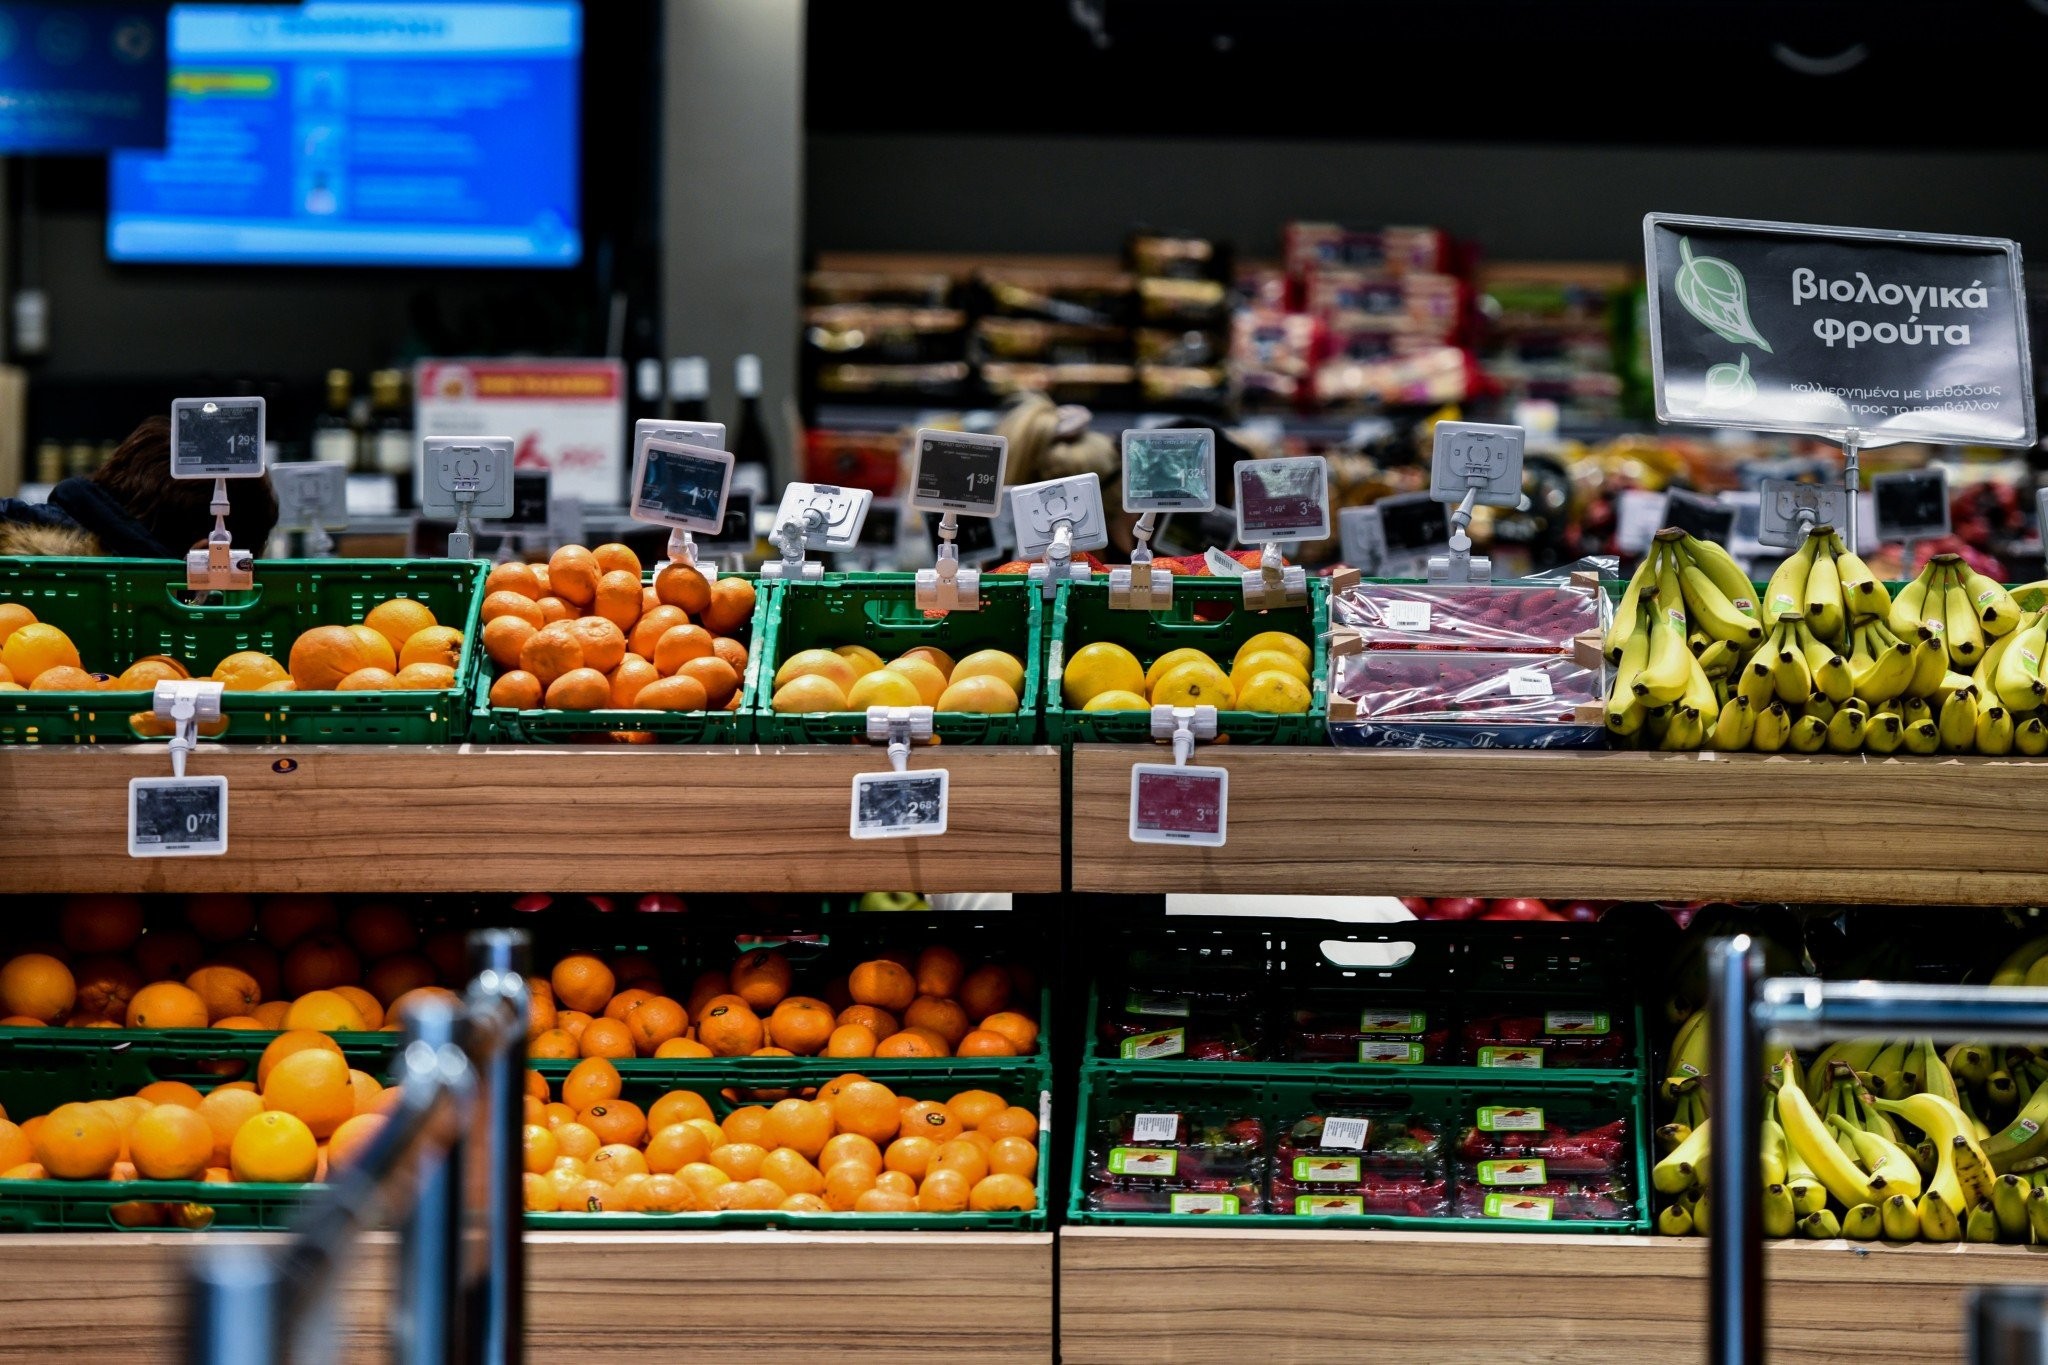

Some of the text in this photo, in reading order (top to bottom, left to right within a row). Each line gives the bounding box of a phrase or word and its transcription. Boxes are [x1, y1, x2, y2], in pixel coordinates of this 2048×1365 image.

[1792, 267, 1988, 314] βιολογικά
[1813, 315, 1970, 348] φρούτα
[1903, 389, 1921, 401] με
[1851, 404, 1888, 416] προς
